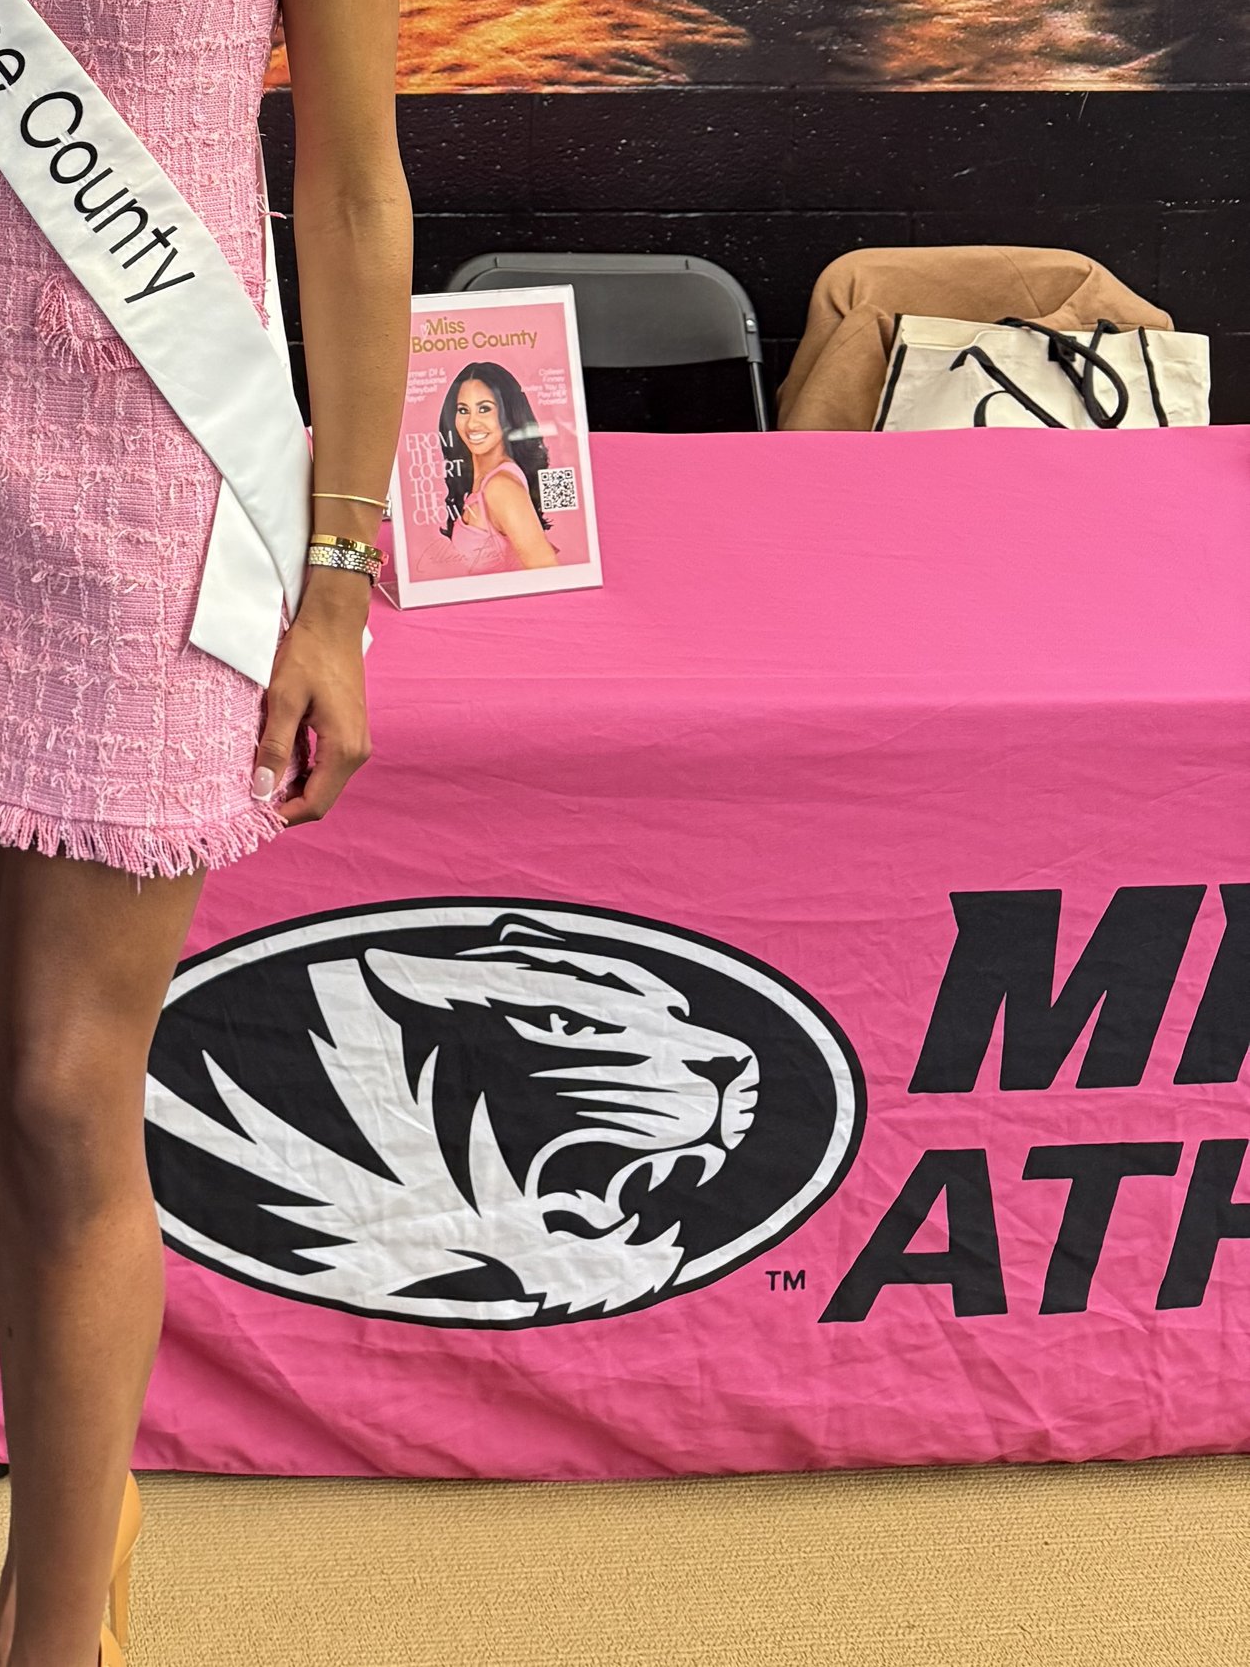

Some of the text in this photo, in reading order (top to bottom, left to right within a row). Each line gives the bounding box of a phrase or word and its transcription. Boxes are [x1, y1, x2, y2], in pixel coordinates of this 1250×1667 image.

[20, 91, 195, 304] County
[426, 316, 466, 336] Miss
[411, 330, 537, 353] Boone County
[406, 430, 454, 452] FROM
[411, 447, 440, 465] THE
[409, 459, 464, 479] COURT
[411, 478, 434, 495] TO
[411, 492, 443, 511] THE
[765, 1270, 806, 1291] TM
